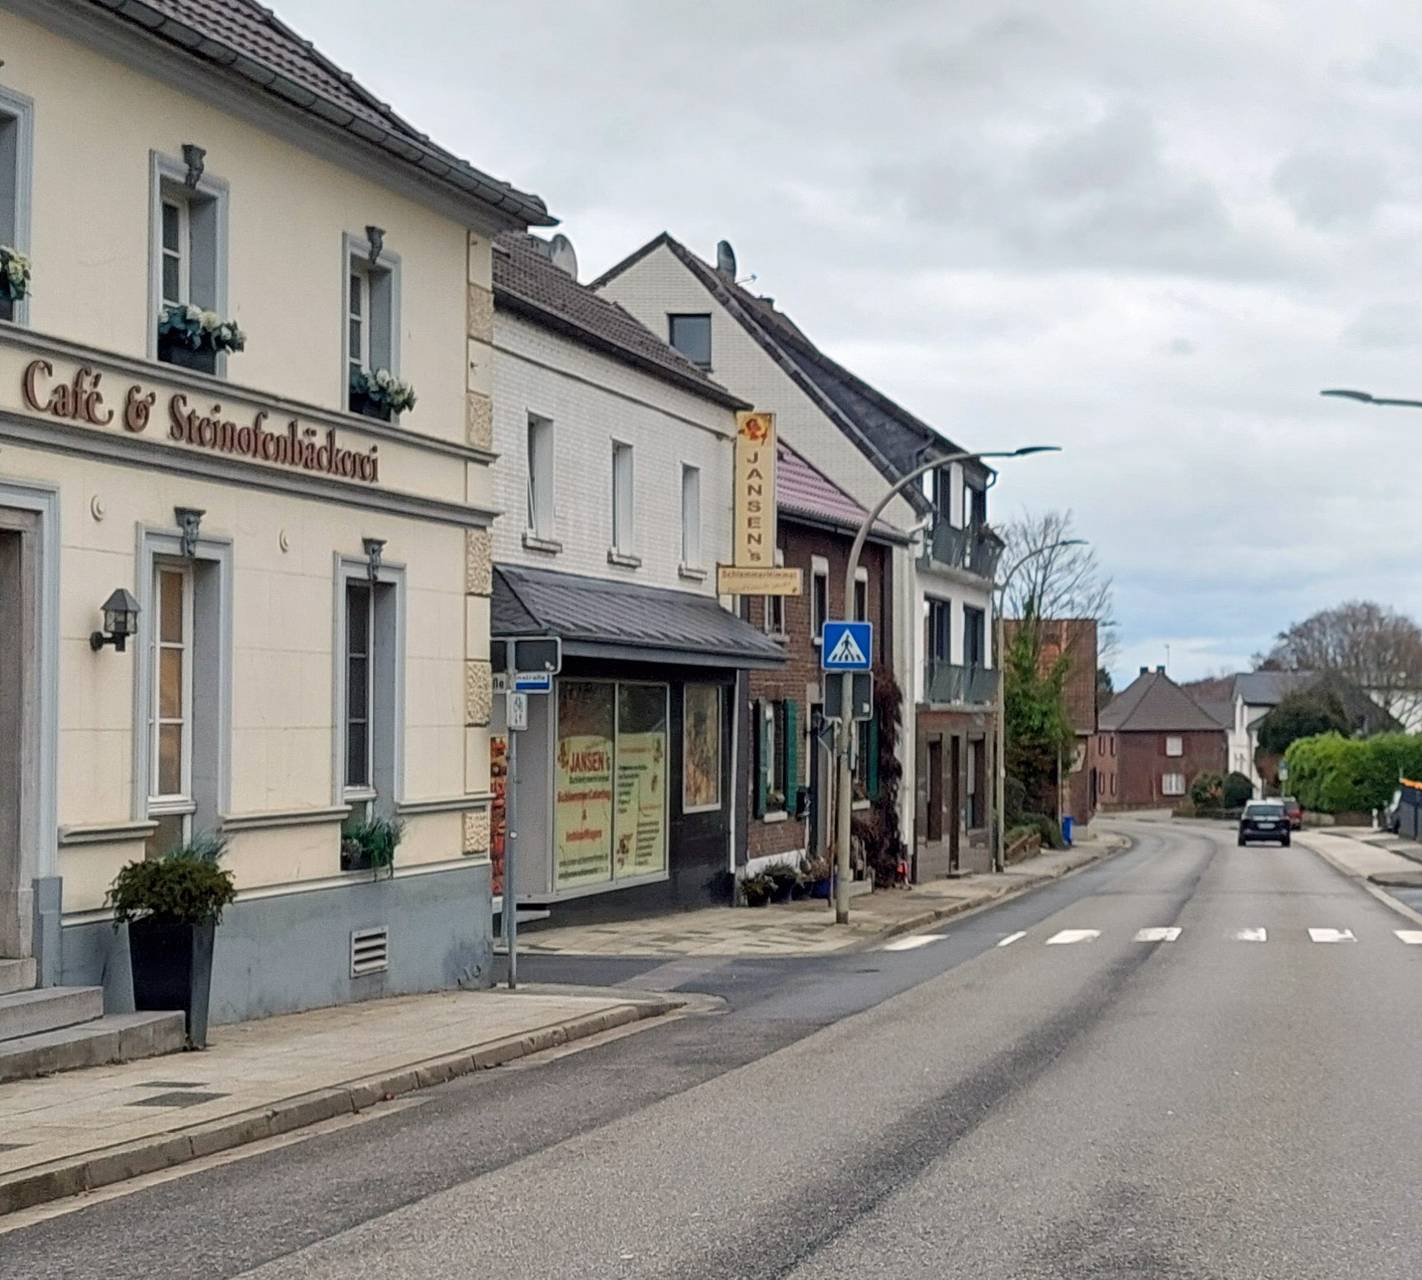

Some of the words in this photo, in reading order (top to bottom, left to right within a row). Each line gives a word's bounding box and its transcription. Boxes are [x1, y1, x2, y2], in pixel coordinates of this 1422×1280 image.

[22, 359, 114, 427] Café
[123, 384, 156, 433] &
[168, 394, 380, 483] Steinofenbäckerei
